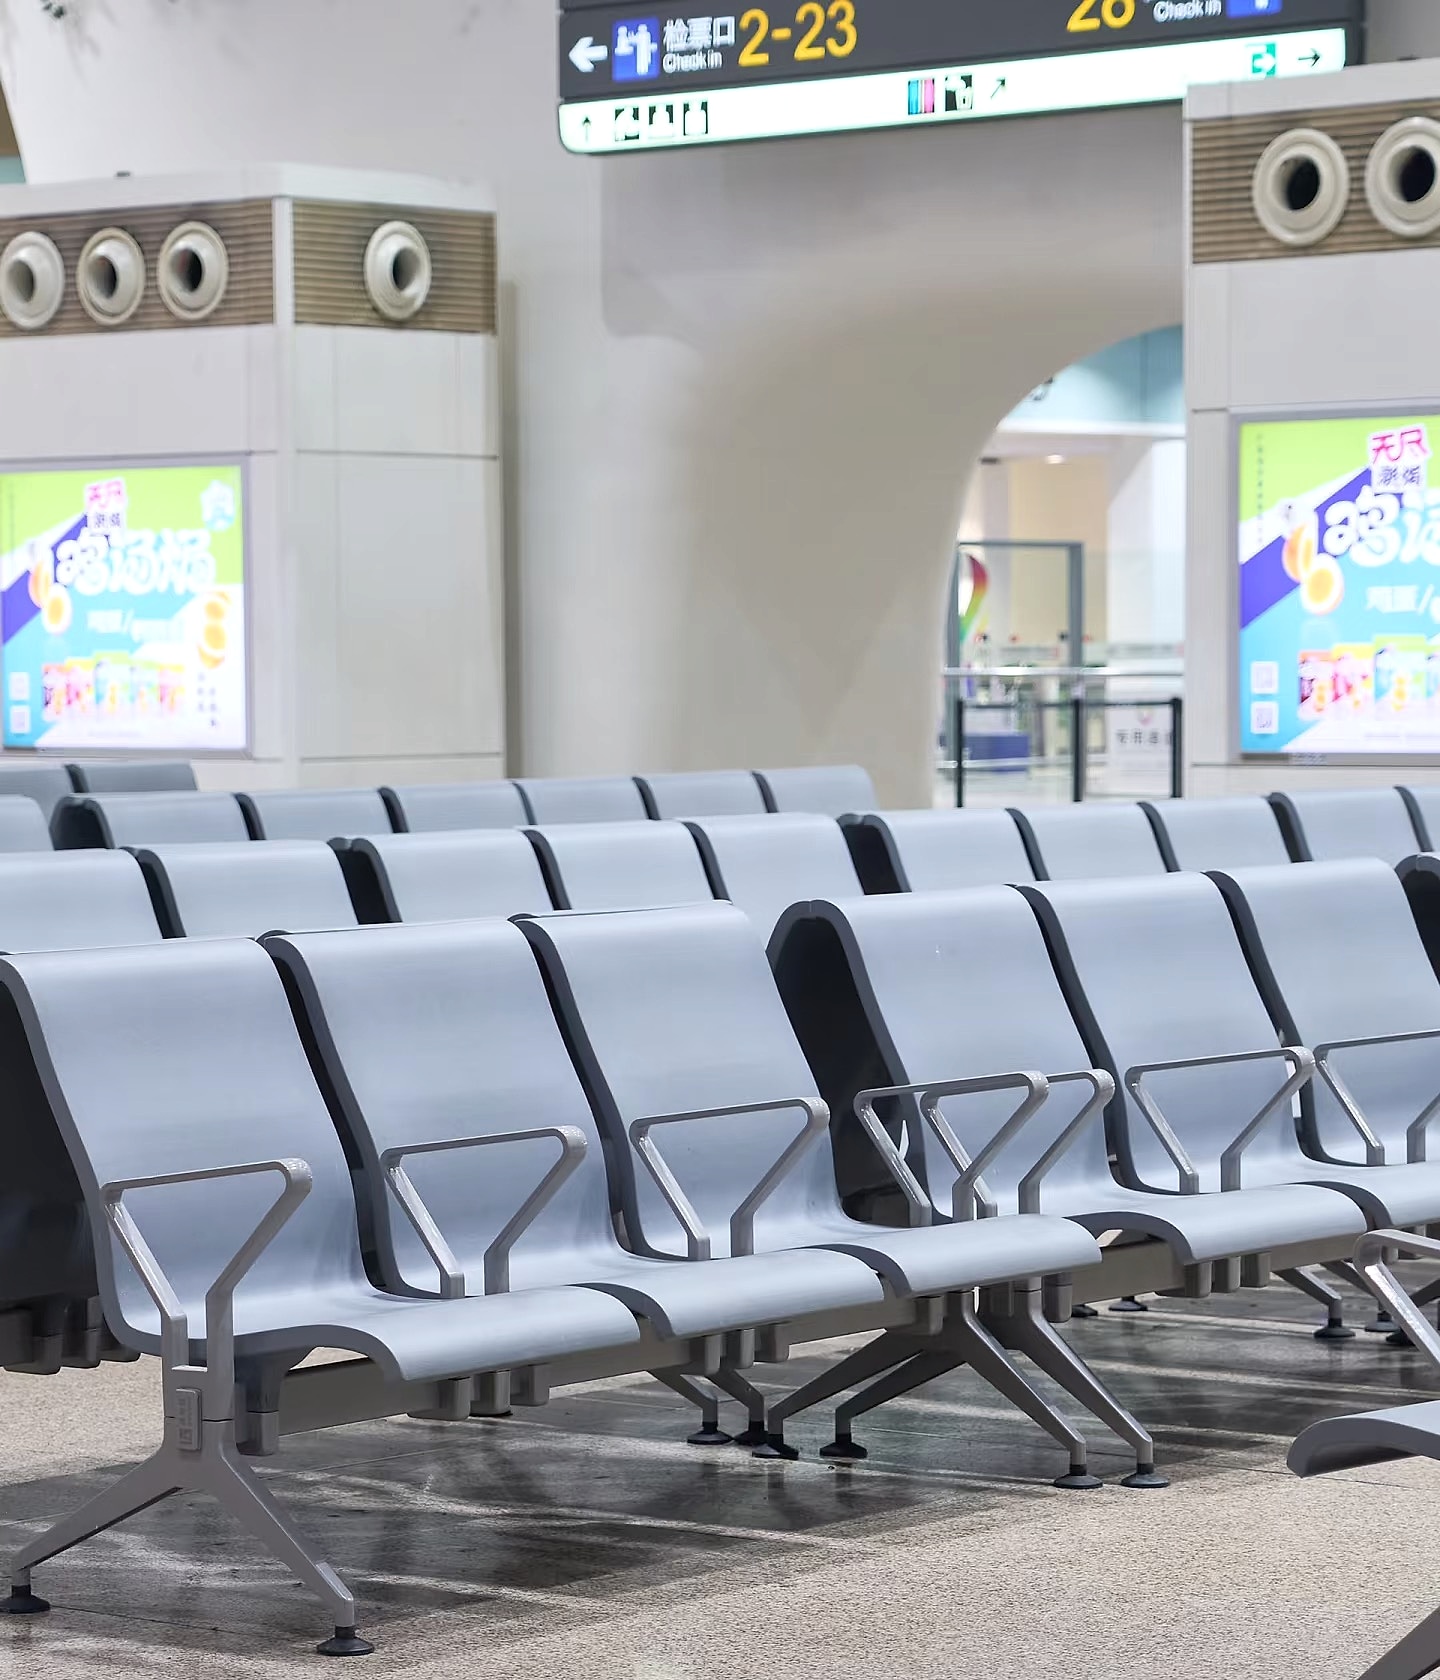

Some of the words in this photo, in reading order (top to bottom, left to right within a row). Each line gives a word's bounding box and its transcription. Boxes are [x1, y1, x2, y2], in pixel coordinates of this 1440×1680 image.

[1153, 1, 1203, 22] Check
[663, 16, 735, 52] 检票口
[738, 0, 857, 67] 2-23
[663, 51, 706, 73] Check
[707, 49, 722, 69] in
